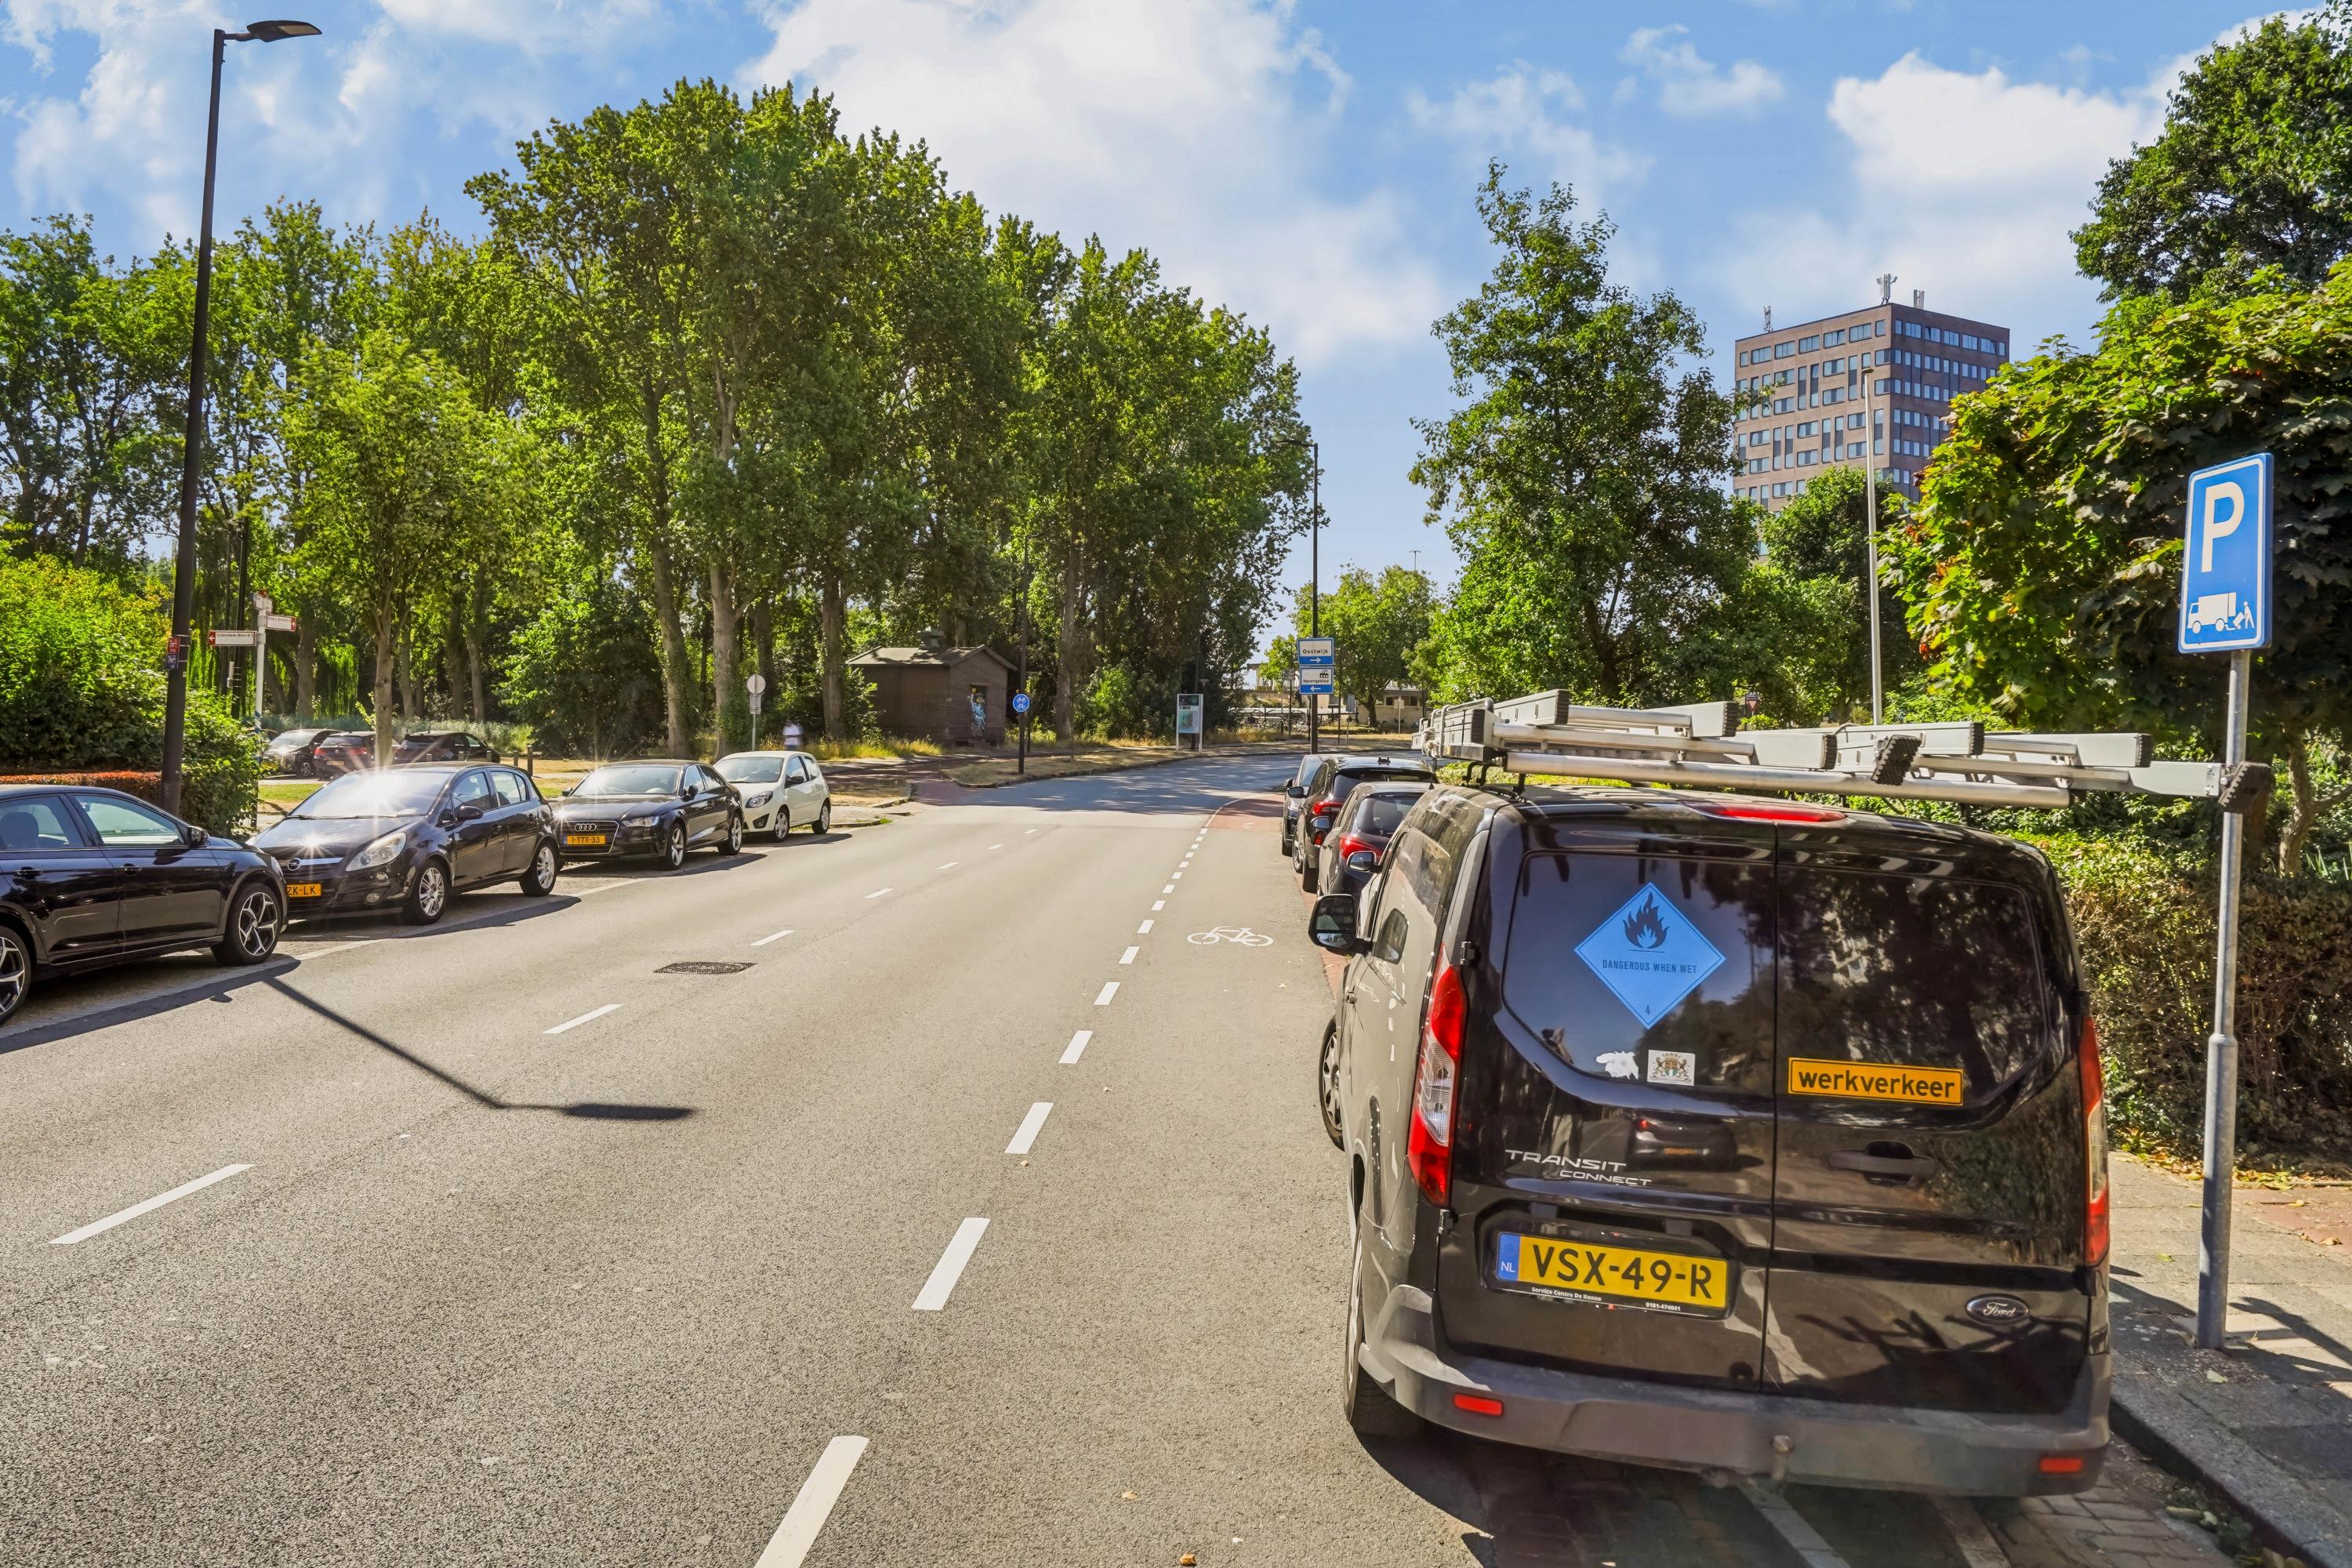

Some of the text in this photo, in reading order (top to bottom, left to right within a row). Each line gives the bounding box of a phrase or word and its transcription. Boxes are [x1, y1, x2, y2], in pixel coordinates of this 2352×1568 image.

[2201, 481, 2245, 573] P
[1602, 960, 1697, 974] DANGEROUS WHEN WET
[1645, 1004, 1651, 1015] 4
[1798, 1069, 1955, 1098] werkverkeer
[1504, 1149, 1627, 1172] TRANSIT
[1559, 1170, 1652, 1186] CONNECT
[1501, 1261, 1516, 1273] NL
[1533, 1244, 1712, 1299] VSX-49-R
[1531, 1287, 1553, 1295] Service
[1983, 1301, 2016, 1317] Ford
